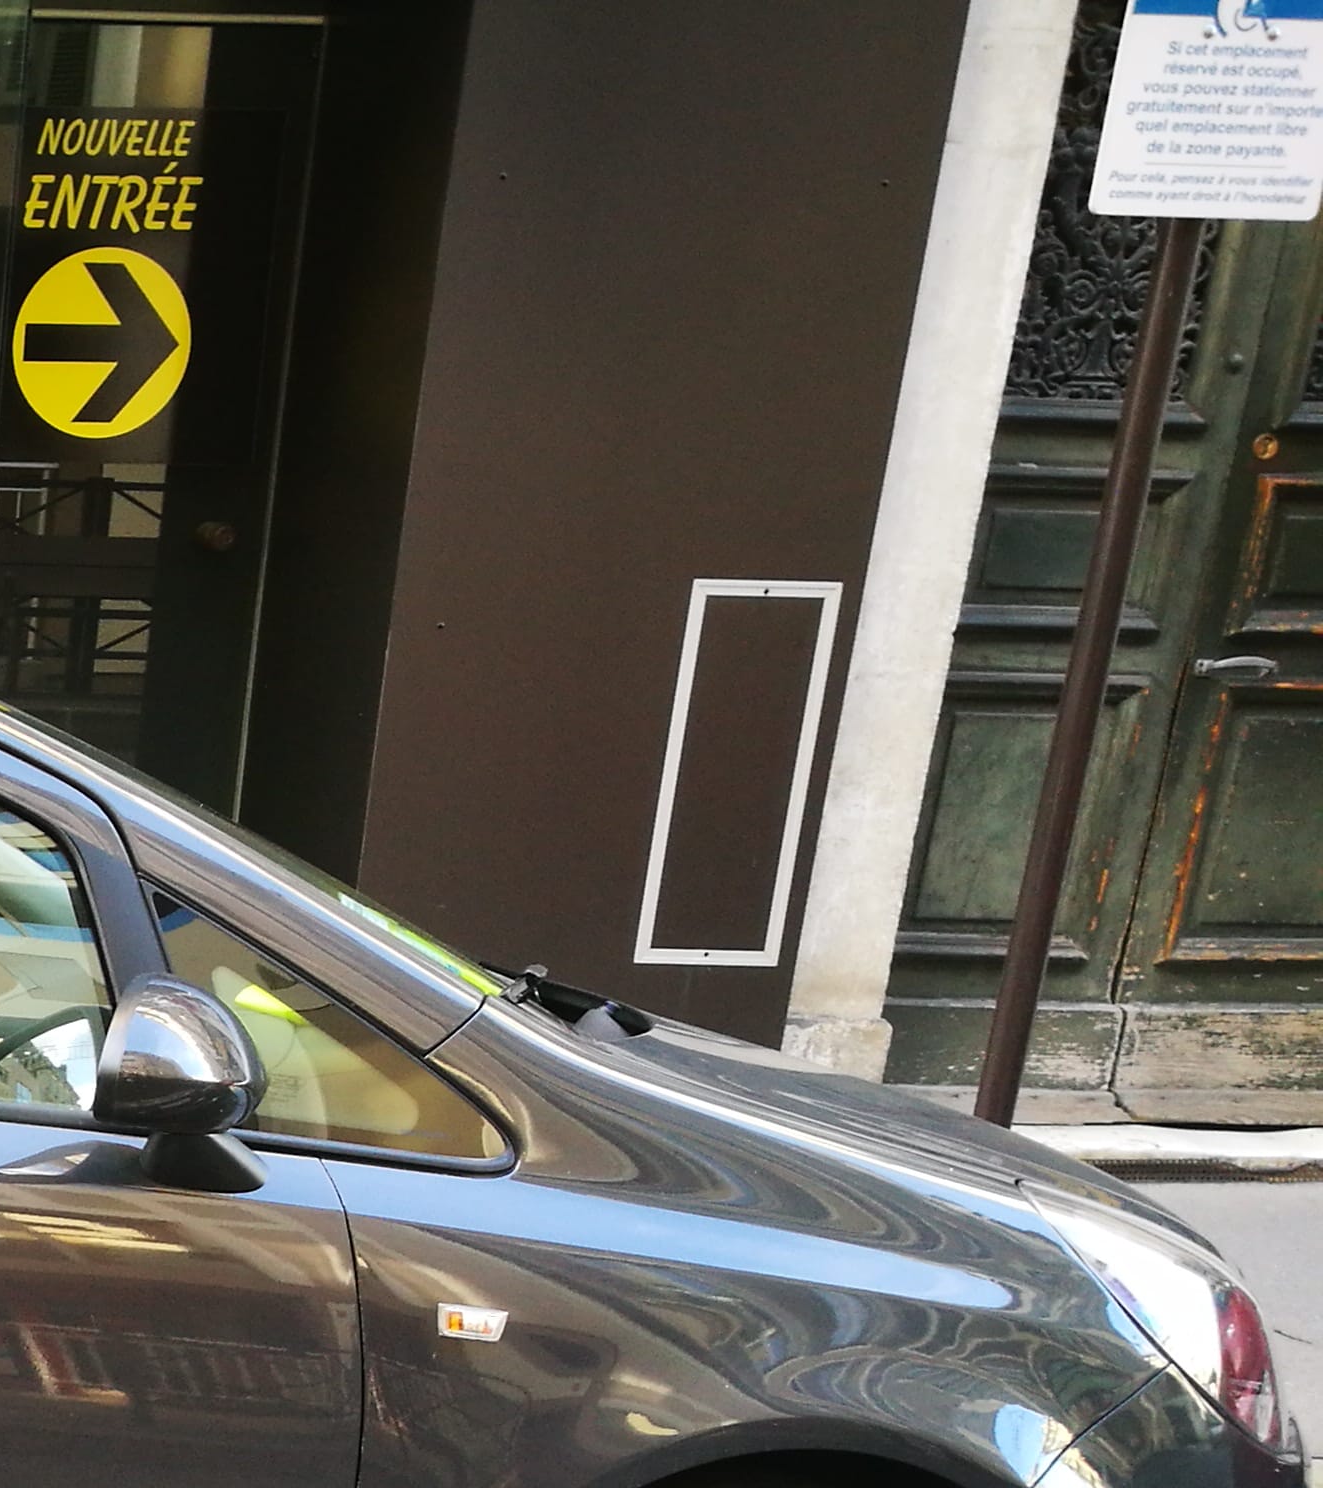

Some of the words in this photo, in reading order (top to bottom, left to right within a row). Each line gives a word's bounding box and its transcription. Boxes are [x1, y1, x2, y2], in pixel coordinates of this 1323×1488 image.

[1166, 40, 1182, 56] Si
[1185, 42, 1210, 57] cet
[1212, 43, 1309, 61] emplacement
[1163, 61, 1218, 76] réservé
[1221, 63, 1244, 77] est
[1142, 82, 1179, 95] vous
[1182, 83, 1238, 101] pouvez
[1241, 82, 1317, 98] stationner
[1125, 100, 1222, 116] gratuitement
[1226, 103, 1249, 116] sur
[36, 117, 196, 157] NOUVELLE
[1135, 118, 1168, 135] quel
[1171, 120, 1274, 139] emplacement
[1275, 123, 1308, 138] libre
[1146, 138, 1165, 154] de
[1168, 139, 1182, 155] la
[1186, 142, 1222, 156] zone
[23, 161, 204, 234] ENTRÉE
